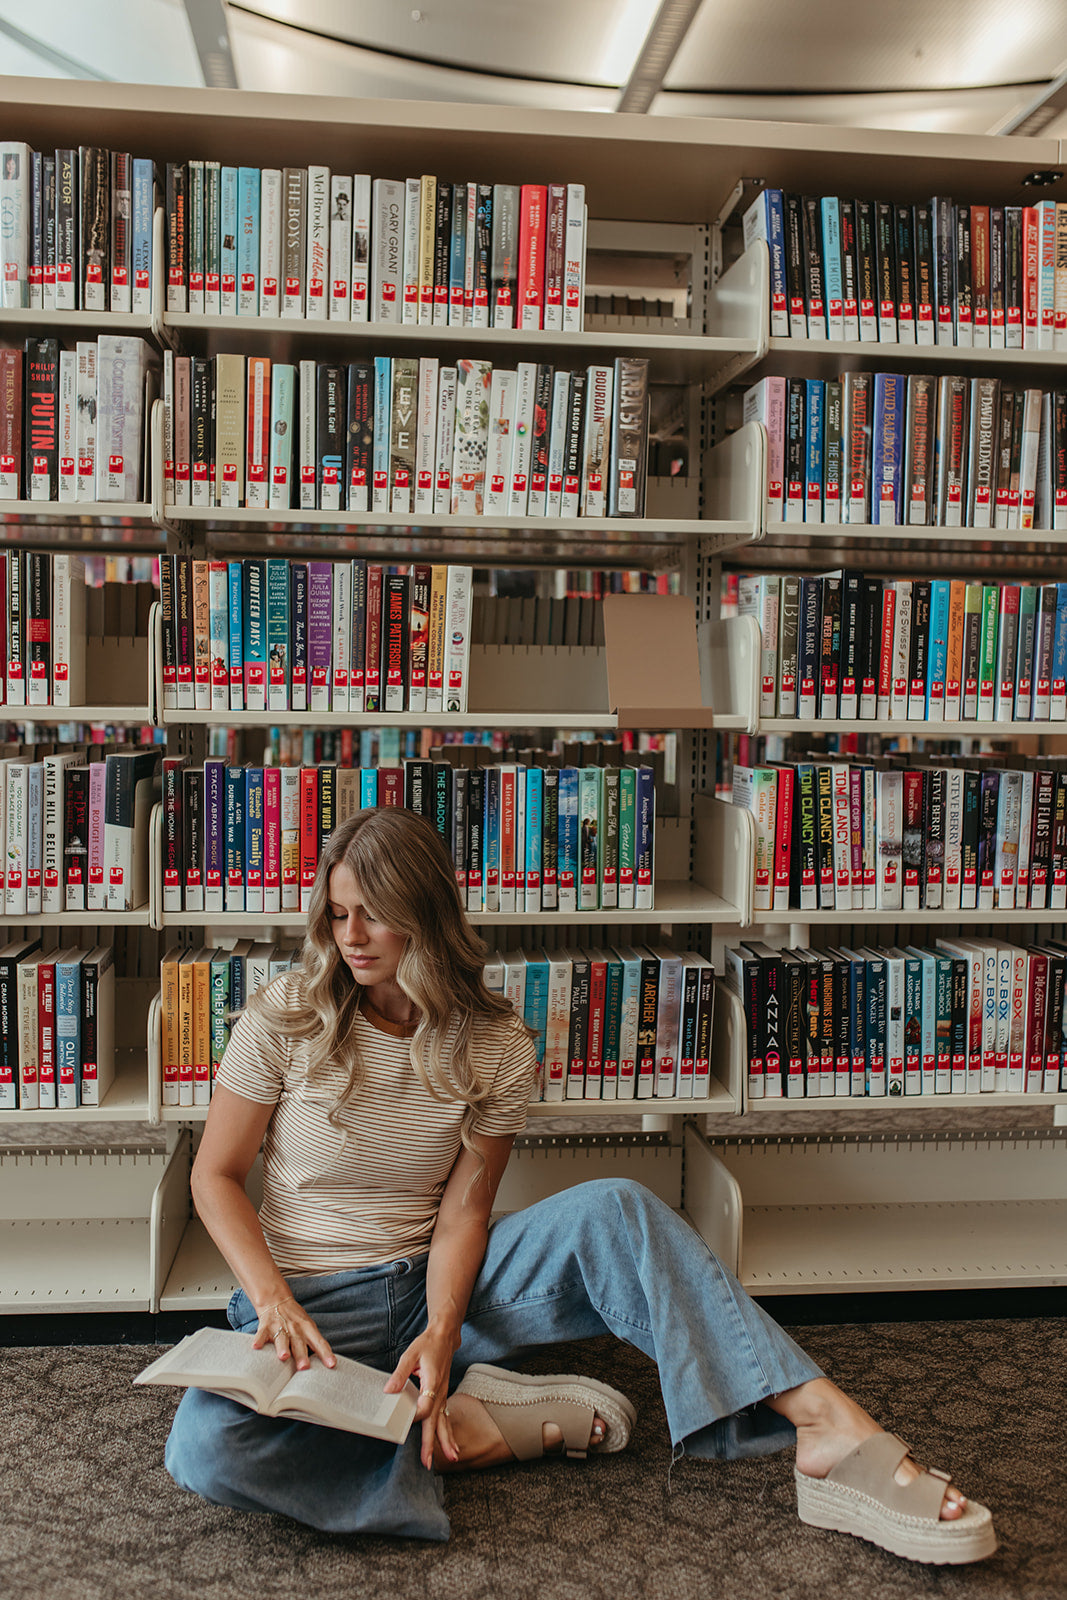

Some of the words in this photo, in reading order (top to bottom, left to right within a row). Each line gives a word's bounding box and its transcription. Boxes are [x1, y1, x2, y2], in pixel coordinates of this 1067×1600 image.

[62, 162, 71, 204] ASTOR
[288, 172, 301, 204] THE
[314, 174, 324, 195] Mel
[1, 196, 14, 239] GOD
[244, 215, 253, 235] YES
[288, 209, 300, 248] BOYS
[313, 198, 324, 242] Brooks
[389, 203, 399, 233] CARY
[1043, 207, 1055, 227] ACE
[1057, 209, 1067, 229] ACE
[66, 217, 74, 256] Anderson
[1028, 224, 1037, 241] ACE
[1042, 228, 1055, 267] ATKINS
[388, 236, 398, 274] GRANT
[529, 236, 537, 276] COLLISION
[773, 243, 781, 270] Alone
[1028, 244, 1037, 277] ATKINS
[1057, 231, 1067, 268] ATKINS
[424, 257, 432, 280] Inside
[6, 370, 14, 386] THE
[30, 363, 55, 371] PHILIP
[31, 373, 54, 381] SHORT
[6, 388, 14, 410] KING
[66, 403, 70, 412] MY
[593, 370, 607, 423] BOURDAIN
[852, 391, 866, 427] DAVID
[884, 378, 896, 411] DAVID
[915, 393, 928, 424] DAVID
[952, 394, 963, 423] DAVID
[31, 392, 54, 450] PUTIN
[572, 408, 580, 431] BLOOD
[980, 397, 993, 429] DAVID
[882, 412, 895, 464] BALDACCI
[913, 426, 927, 476] BALDACCI
[951, 424, 962, 469] BALDACCI
[978, 431, 992, 482] BALDACCI
[161, 561, 171, 580] KATE
[162, 582, 172, 621] ATKINSON
[180, 594, 188, 619] Atwood
[250, 566, 261, 618] FOURTEEN
[390, 591, 403, 620] JAMES
[785, 603, 798, 617] 13
[806, 593, 816, 628] NEVADA
[900, 601, 910, 617] Big
[250, 621, 260, 646] DAYS
[823, 616, 832, 639] NEVER
[833, 621, 840, 632] WE
[899, 618, 909, 650] Swiss
[389, 624, 402, 670] PATTERSON
[413, 642, 426, 662] SINS
[805, 632, 816, 655] BARR
[823, 639, 832, 656] HERE
[46, 762, 56, 796] ANITA
[322, 769, 331, 783] THE
[413, 766, 422, 777] THE
[437, 771, 446, 789] THE
[801, 769, 812, 795] TOM
[819, 769, 831, 795] TOM
[834, 771, 847, 795] TOM
[933, 770, 942, 800] STEVE
[322, 786, 331, 804] LAST
[504, 783, 512, 805] Mitch
[950, 775, 959, 807] STEVE
[1038, 787, 1051, 804] RED
[46, 801, 55, 826] HILL
[74, 802, 86, 826] DEVIL
[92, 809, 100, 841] ROUGH
[322, 807, 331, 829] WORD
[436, 792, 446, 833] SHADOW
[504, 807, 512, 834] Albom
[802, 797, 813, 845] CLANCY
[820, 797, 832, 845] CLANCY
[836, 798, 848, 846] CLANCY
[931, 804, 941, 839] BERRY
[1037, 807, 1050, 837] FLAGS
[268, 822, 276, 858] Hopeless
[949, 810, 959, 846] BERRY
[168, 842, 176, 868] MEGAN
[250, 828, 261, 866] Family
[214, 978, 224, 1015] OTHER
[572, 986, 580, 1012] PAULA
[580, 979, 588, 1005] LITTLE
[644, 984, 656, 1023] ARCHER
[810, 979, 819, 1007] Mary
[824, 974, 833, 1017] LONGHORNS
[972, 989, 981, 1017] BOX
[986, 987, 995, 1019] BOX
[999, 988, 1009, 1020] BOX
[1014, 988, 1022, 1019] BOX
[182, 1012, 190, 1045] ANTIQUES
[215, 1019, 224, 1049] BIRDS
[766, 994, 779, 1048] ANNA
[810, 1010, 819, 1039] Jane
[821, 1021, 833, 1037] EAST
[43, 1027, 52, 1050] KILLING
[43, 1052, 51, 1063] THE
